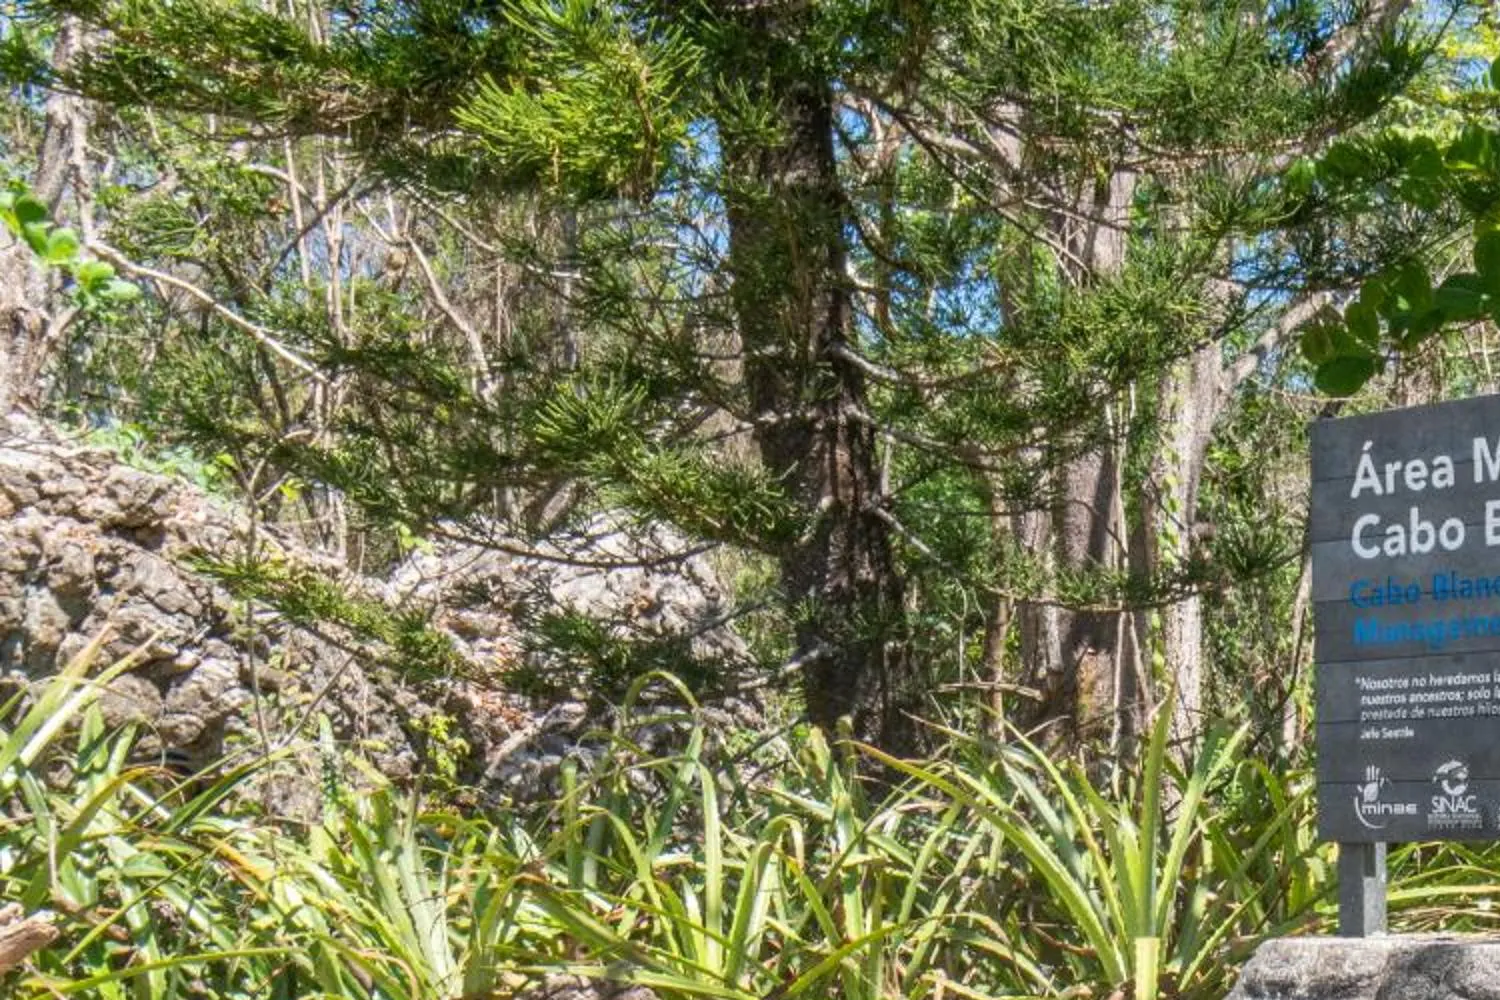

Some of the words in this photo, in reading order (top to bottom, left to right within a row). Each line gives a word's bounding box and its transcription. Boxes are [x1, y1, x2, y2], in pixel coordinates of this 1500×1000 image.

[1350, 441, 1455, 497] Área
[1350, 508, 1465, 560] Cabo
[1350, 577, 1421, 608] Cabo
[1412, 677, 1426, 687] no
[1429, 672, 1491, 686] heredamos
[1360, 692, 1407, 705] nuestros
[1410, 705, 1424, 719] de
[1428, 704, 1475, 718] nuestros
[1382, 726, 1414, 739] Seattle
[1362, 802, 1417, 815] minae
[1431, 795, 1477, 813] SINAC
